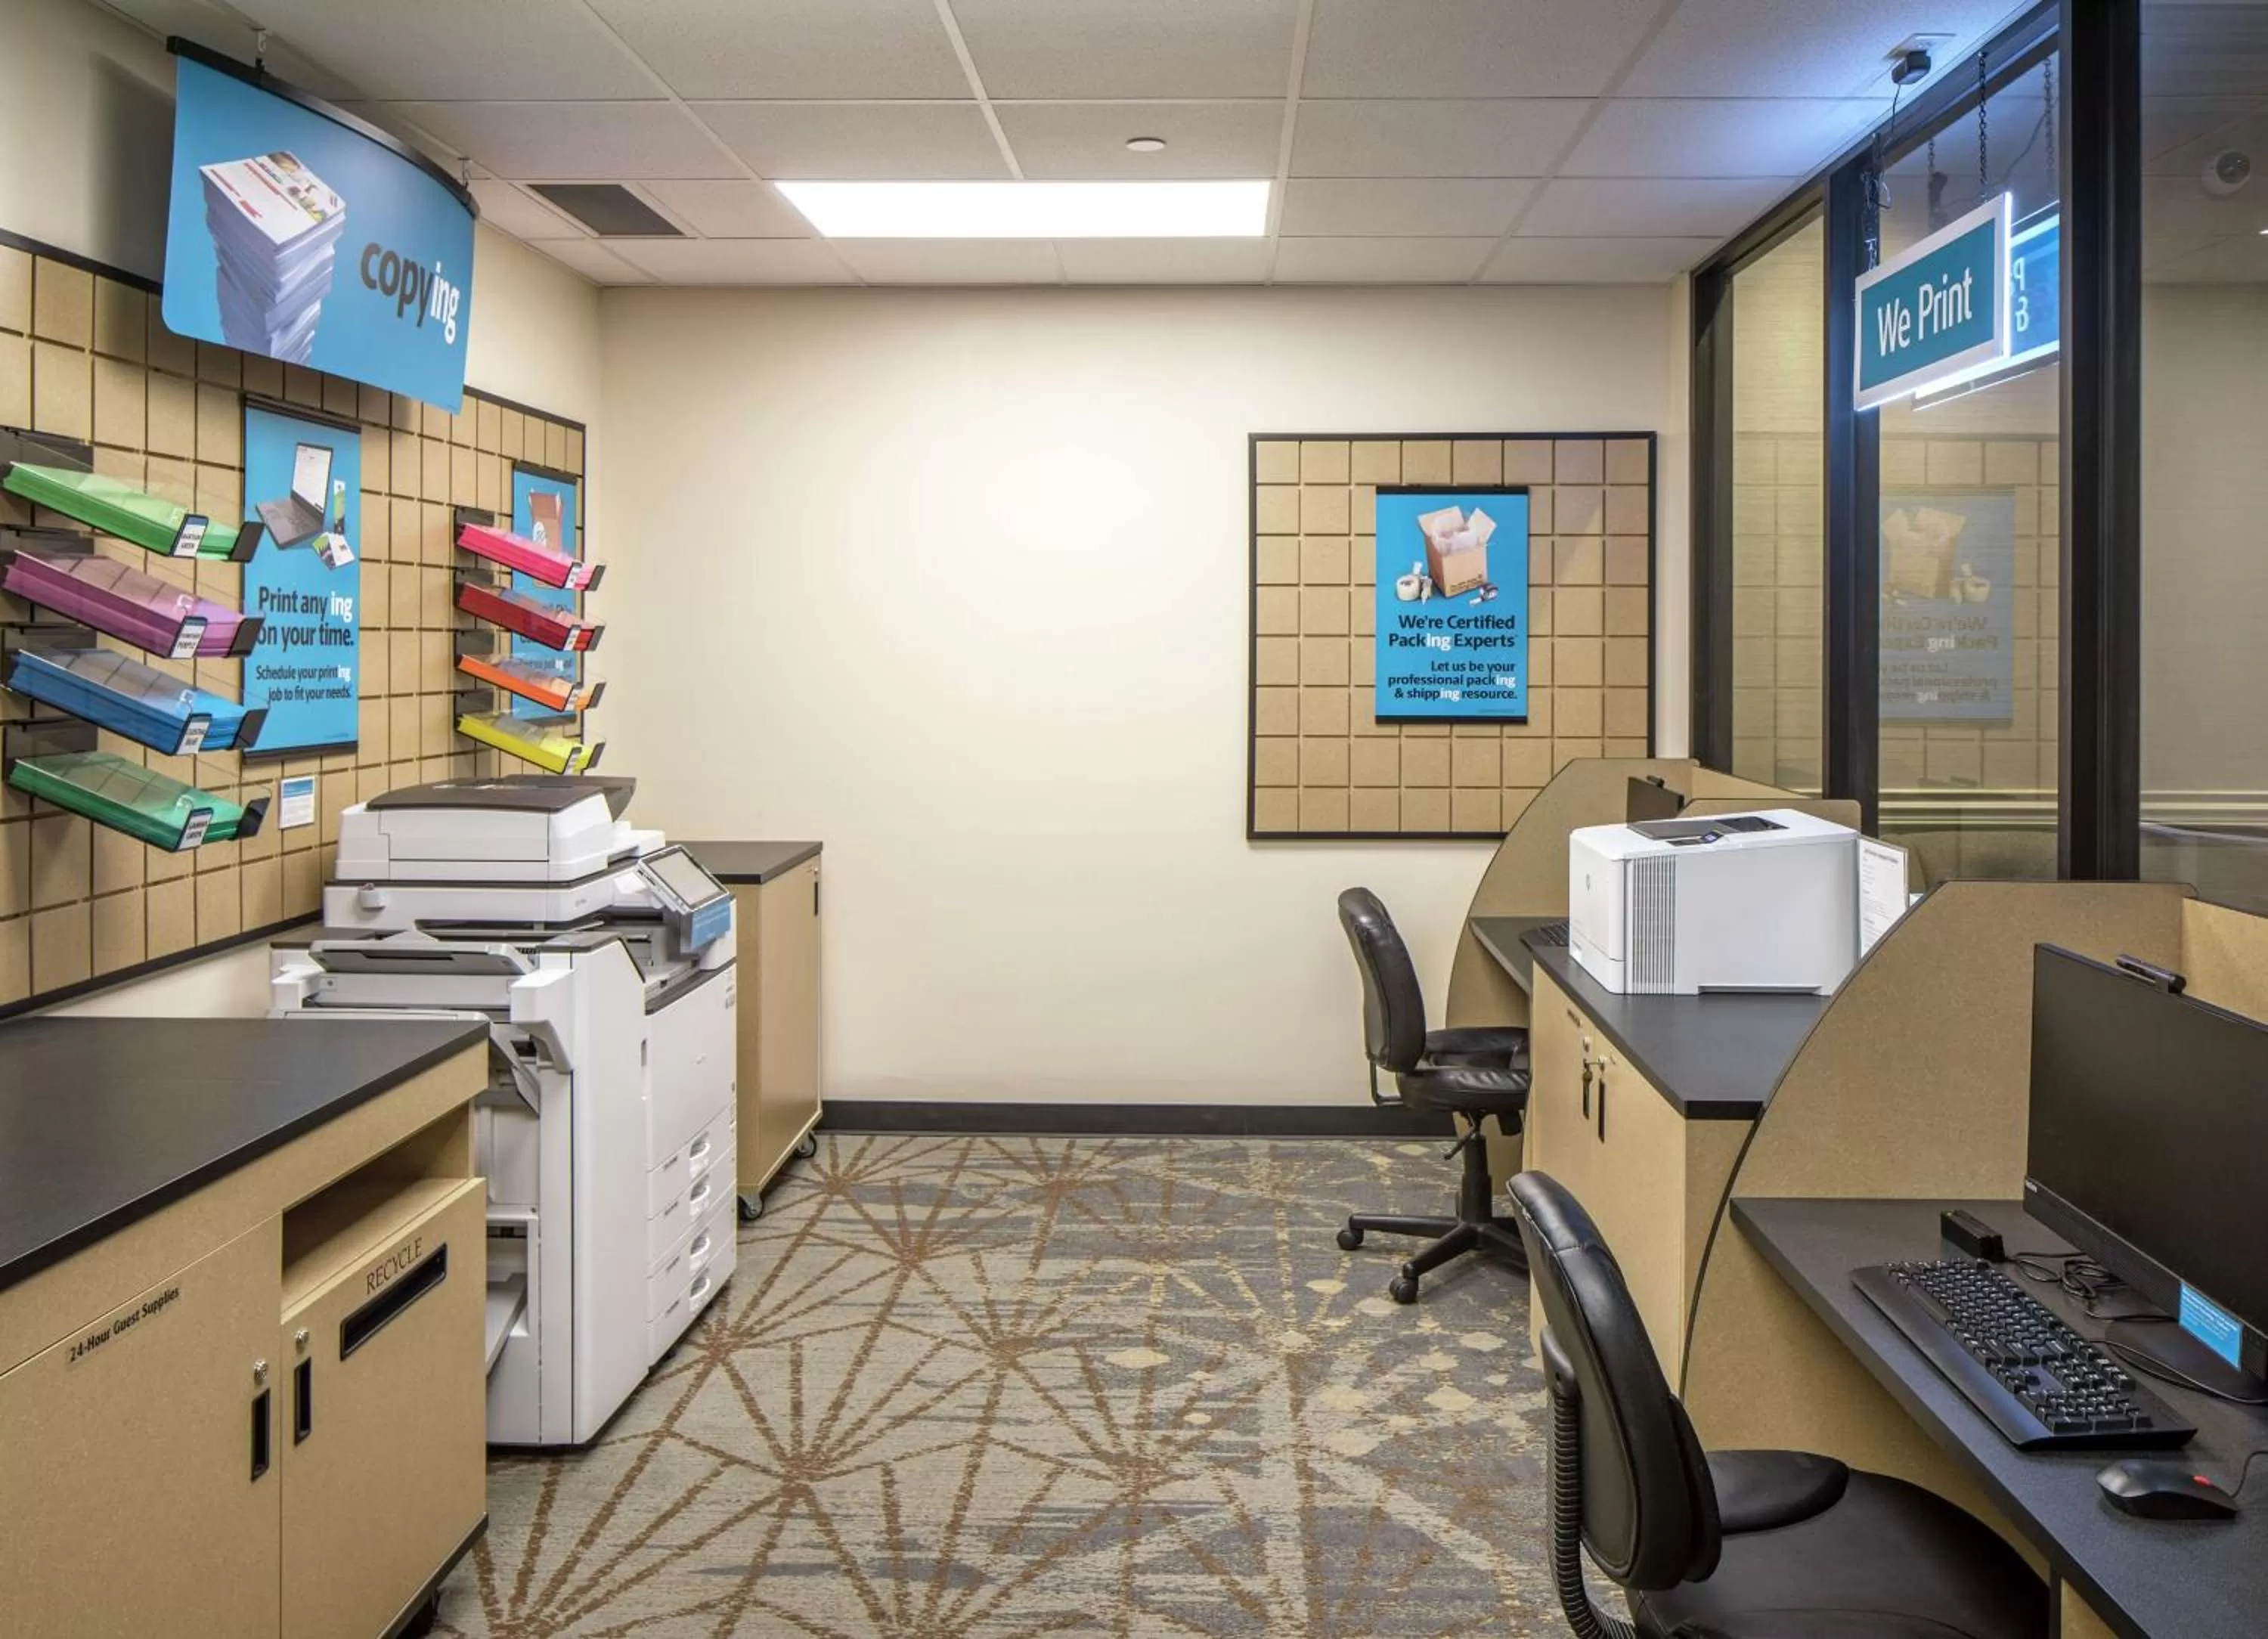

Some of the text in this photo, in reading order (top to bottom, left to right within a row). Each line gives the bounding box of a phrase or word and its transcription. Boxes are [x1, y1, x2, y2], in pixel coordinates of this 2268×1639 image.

[361, 242, 460, 345] copying
[1877, 267, 1972, 357] We Print
[258, 586, 298, 613] Print
[300, 594, 328, 621] any
[1398, 615, 1515, 630] We're Certified
[257, 622, 355, 652] on your time.
[1389, 633, 1452, 651] Packing
[256, 665, 351, 683] Schedule your printing
[1431, 661, 1515, 675] Let us be your
[1387, 674, 1516, 689] professional packing
[268, 686, 352, 705] job to fit your needs.
[1394, 687, 1518, 702] & shipping resource.
[367, 1236, 422, 1294] RECYCLE
[70, 1287, 179, 1362] 24-Hour Guest Supplies
